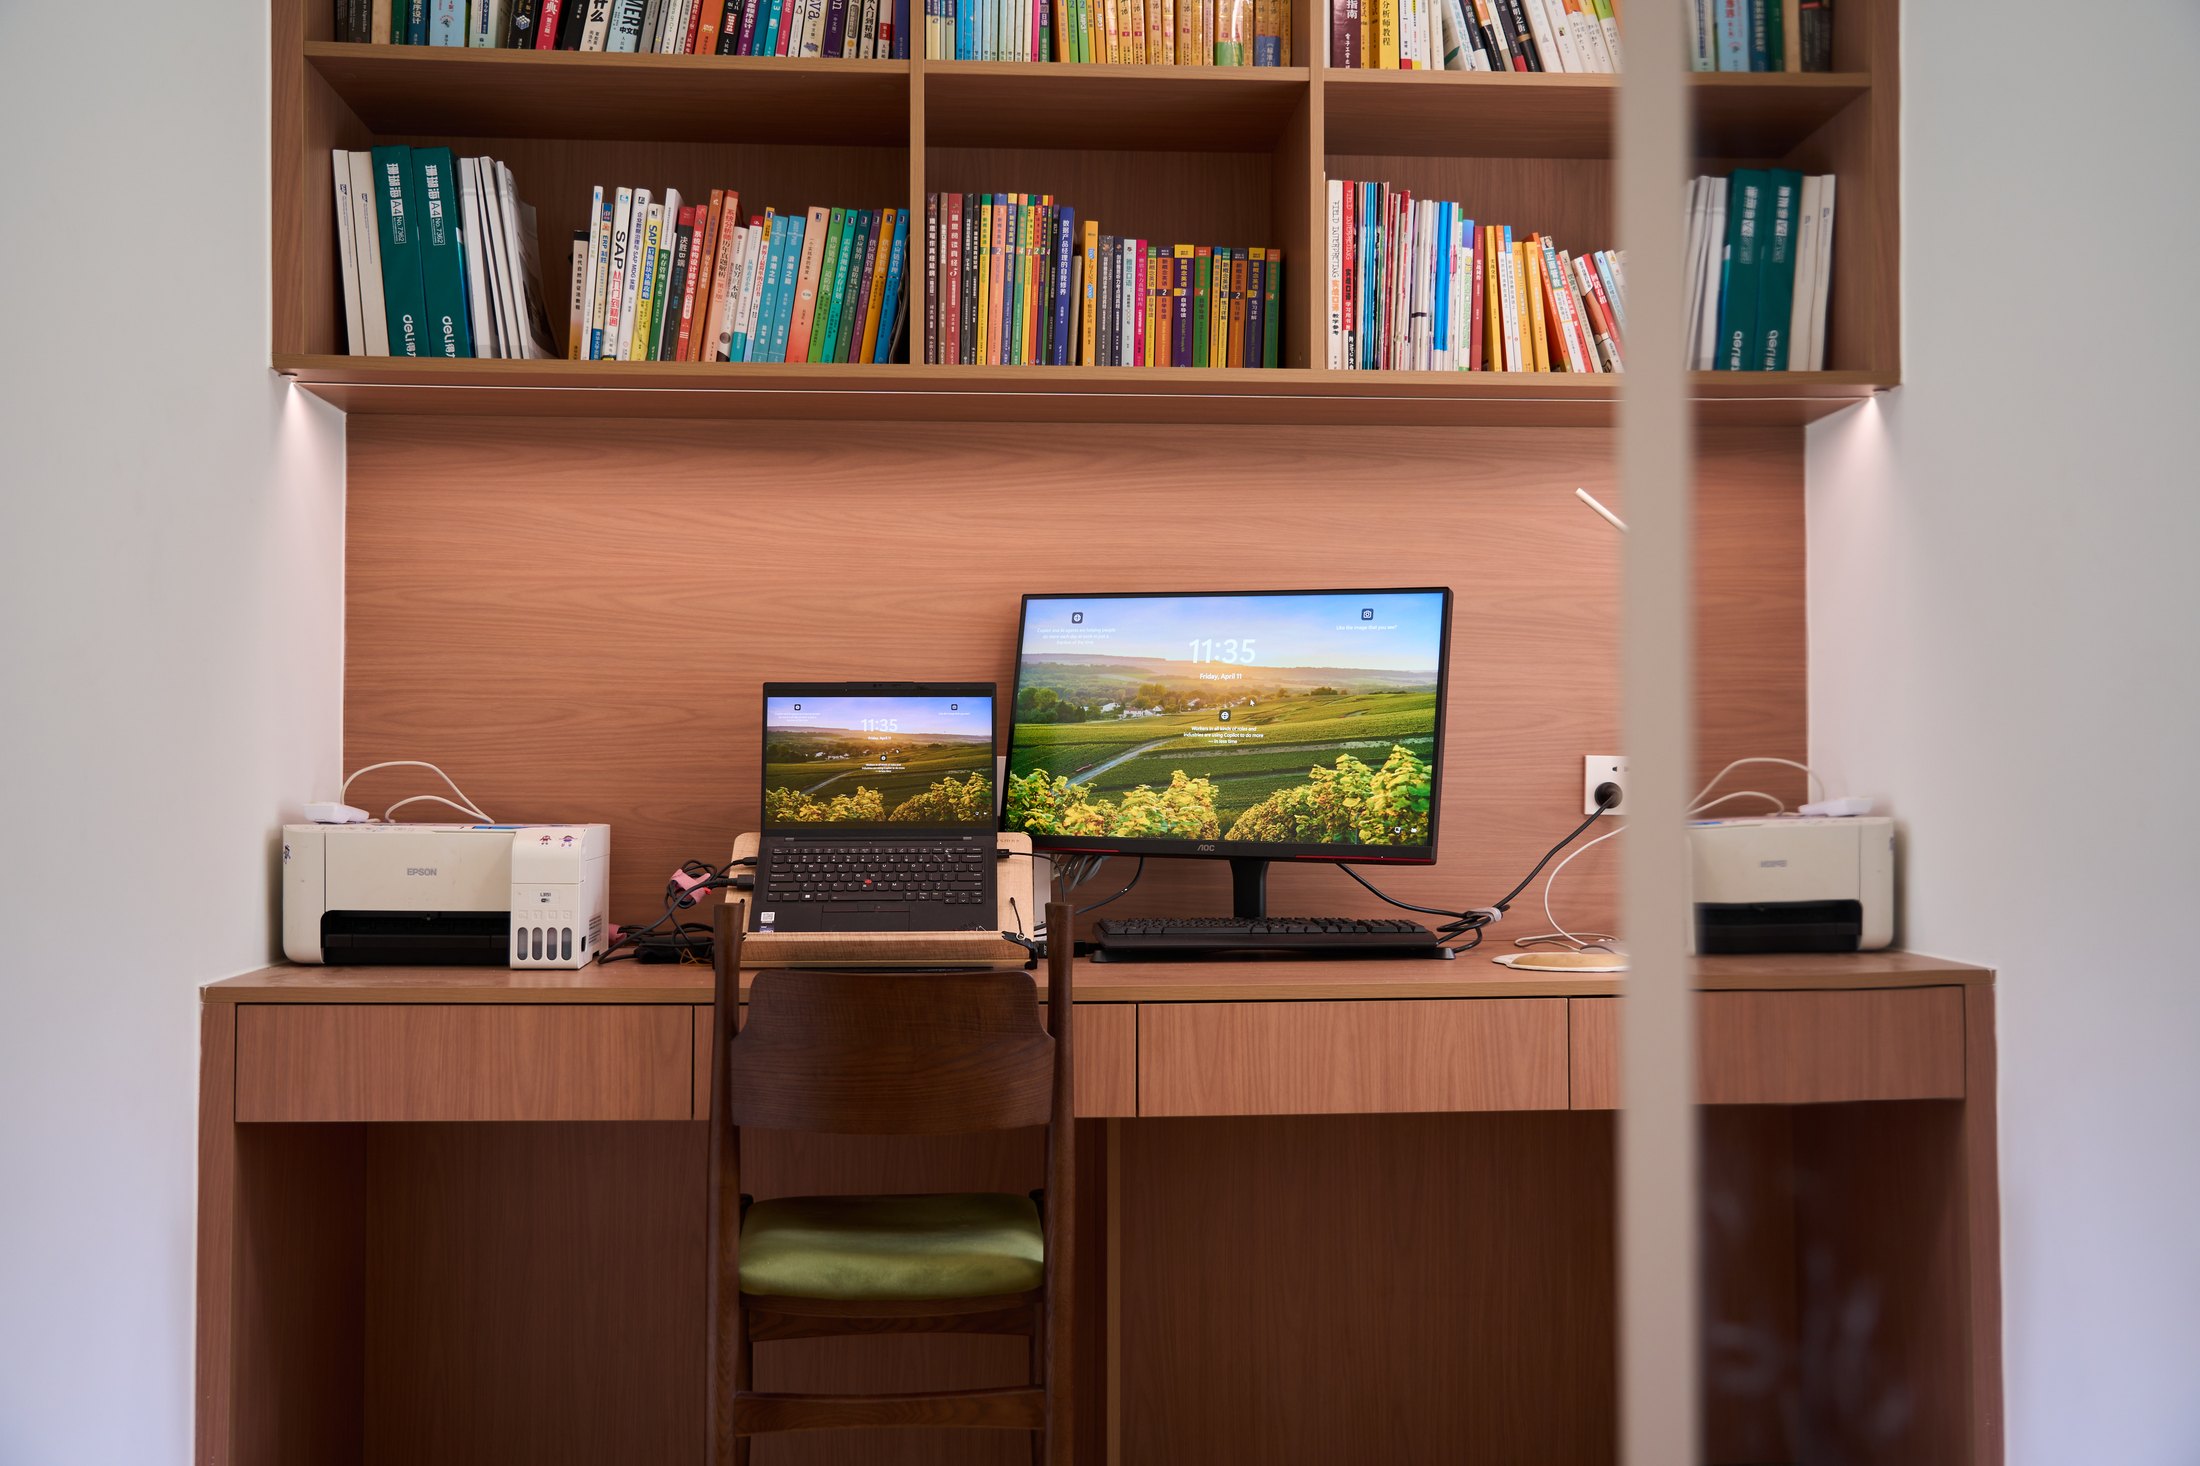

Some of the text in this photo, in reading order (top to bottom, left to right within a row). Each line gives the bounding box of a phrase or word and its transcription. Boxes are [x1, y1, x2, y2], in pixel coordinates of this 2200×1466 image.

[392, 200, 403, 215] A4
[430, 201, 441, 216] A4
[1332, 201, 1340, 224] FIELD
[648, 225, 657, 245] SAP
[614, 230, 626, 270] SAP
[1332, 226, 1340, 278] INTERPRETING
[1189, 638, 1256, 664] 11:35
[1199, 673, 1219, 681] Friday,
[1221, 673, 1236, 681] April
[860, 718, 898, 732] 11:35
[1197, 844, 1215, 852] AOC
[407, 868, 437, 876] EPSON
